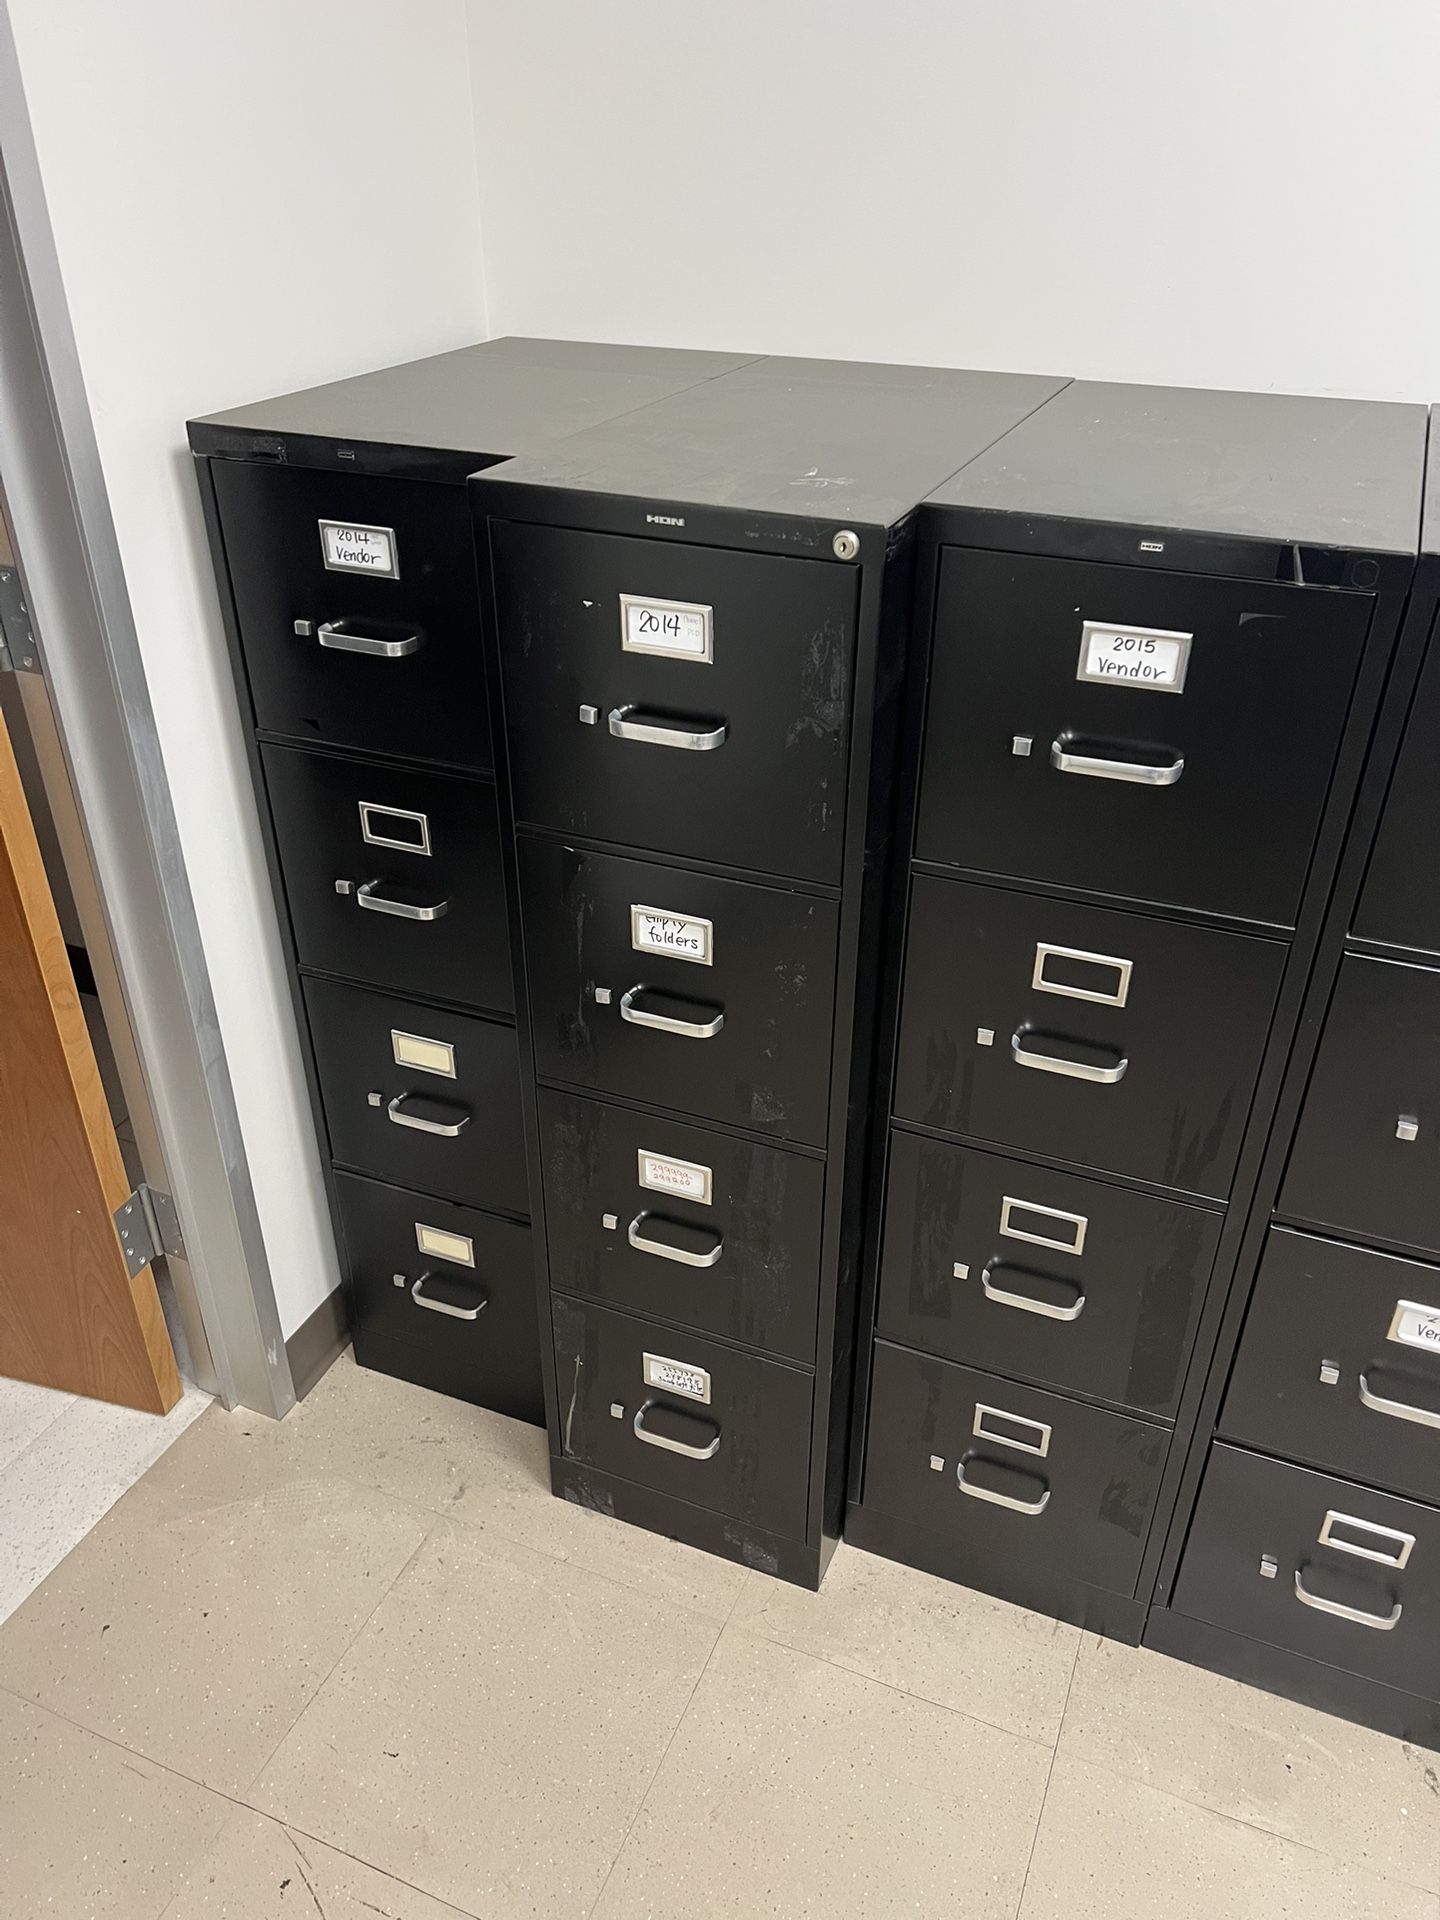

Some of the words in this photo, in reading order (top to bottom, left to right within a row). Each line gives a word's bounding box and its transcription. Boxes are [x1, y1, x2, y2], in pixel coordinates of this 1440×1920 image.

[646, 514, 685, 527] HON
[337, 529, 370, 545] 2014
[336, 546, 382, 564] Vendor
[639, 610, 681, 637] 2014
[1113, 637, 1157, 653] 2015
[1098, 656, 1168, 680] Vendor
[648, 926, 699, 949] folders
